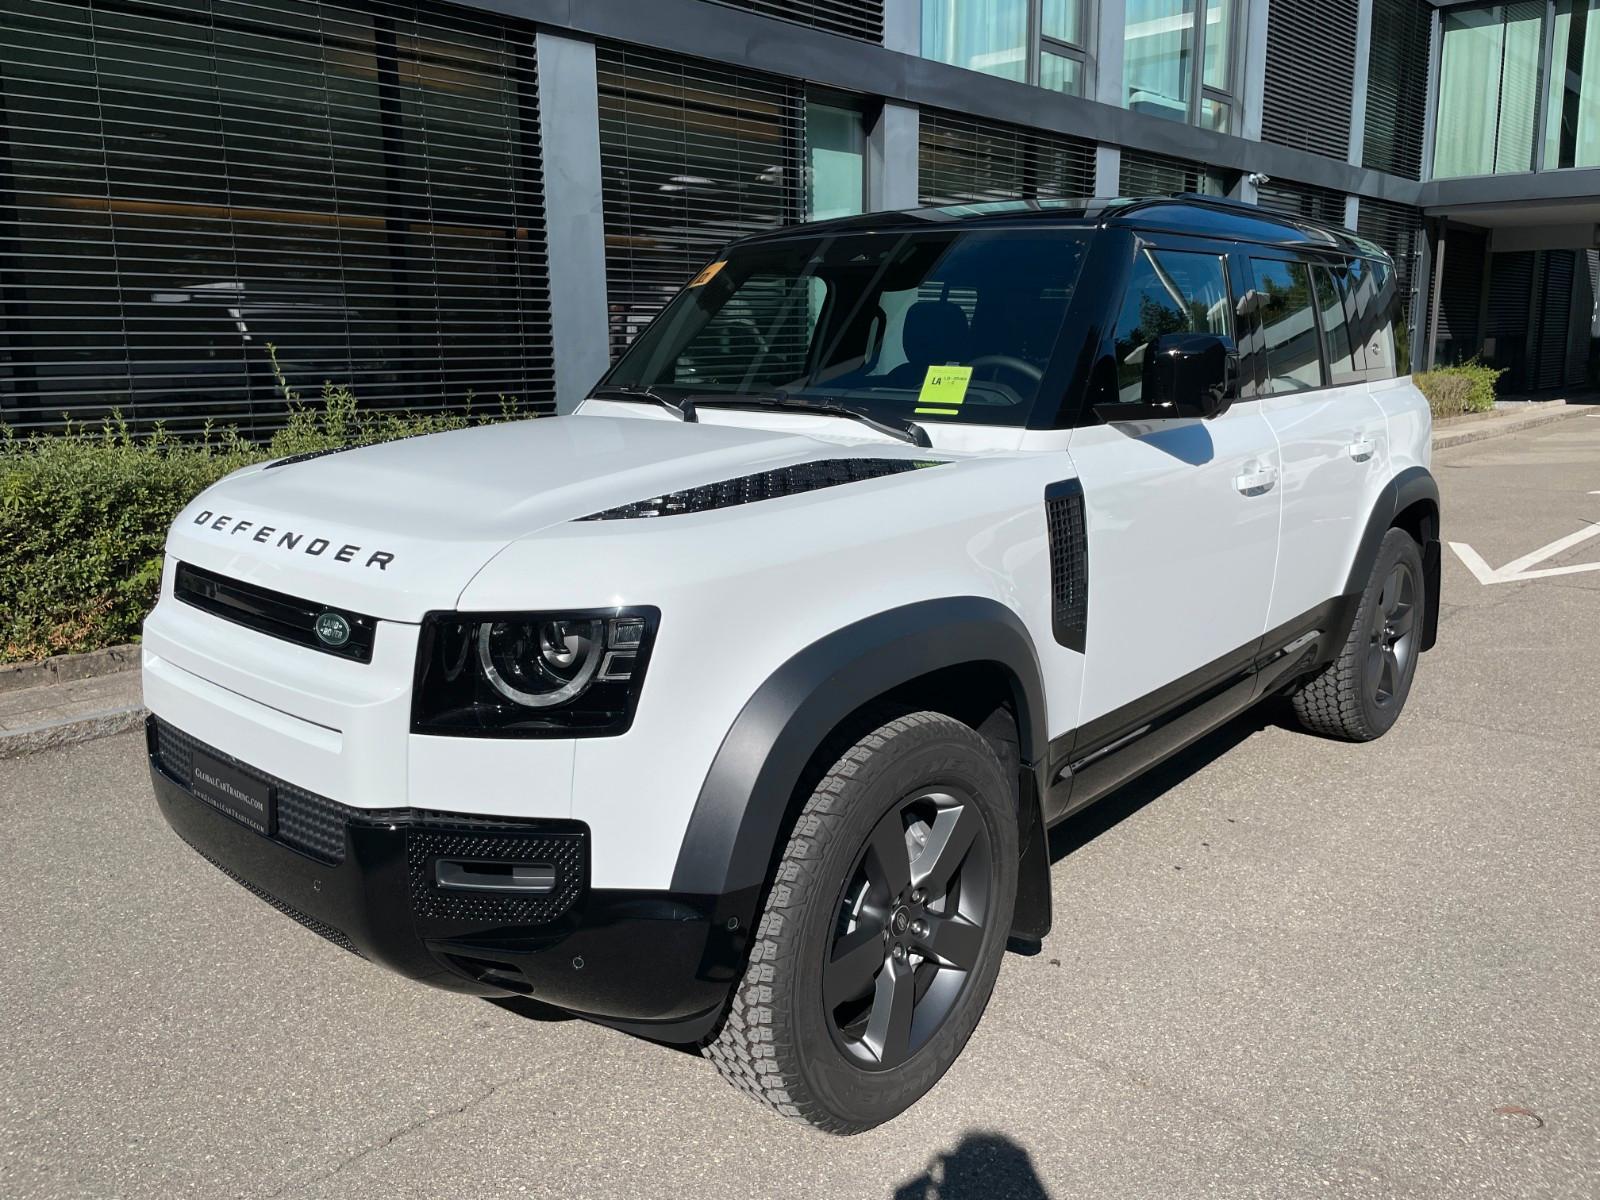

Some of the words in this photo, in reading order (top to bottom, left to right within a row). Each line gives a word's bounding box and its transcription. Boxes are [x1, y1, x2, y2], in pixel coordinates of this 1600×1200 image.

[193, 510, 395, 570] DEFENDER
[322, 618, 340, 630] LAND
[322, 627, 343, 639] ROVER
